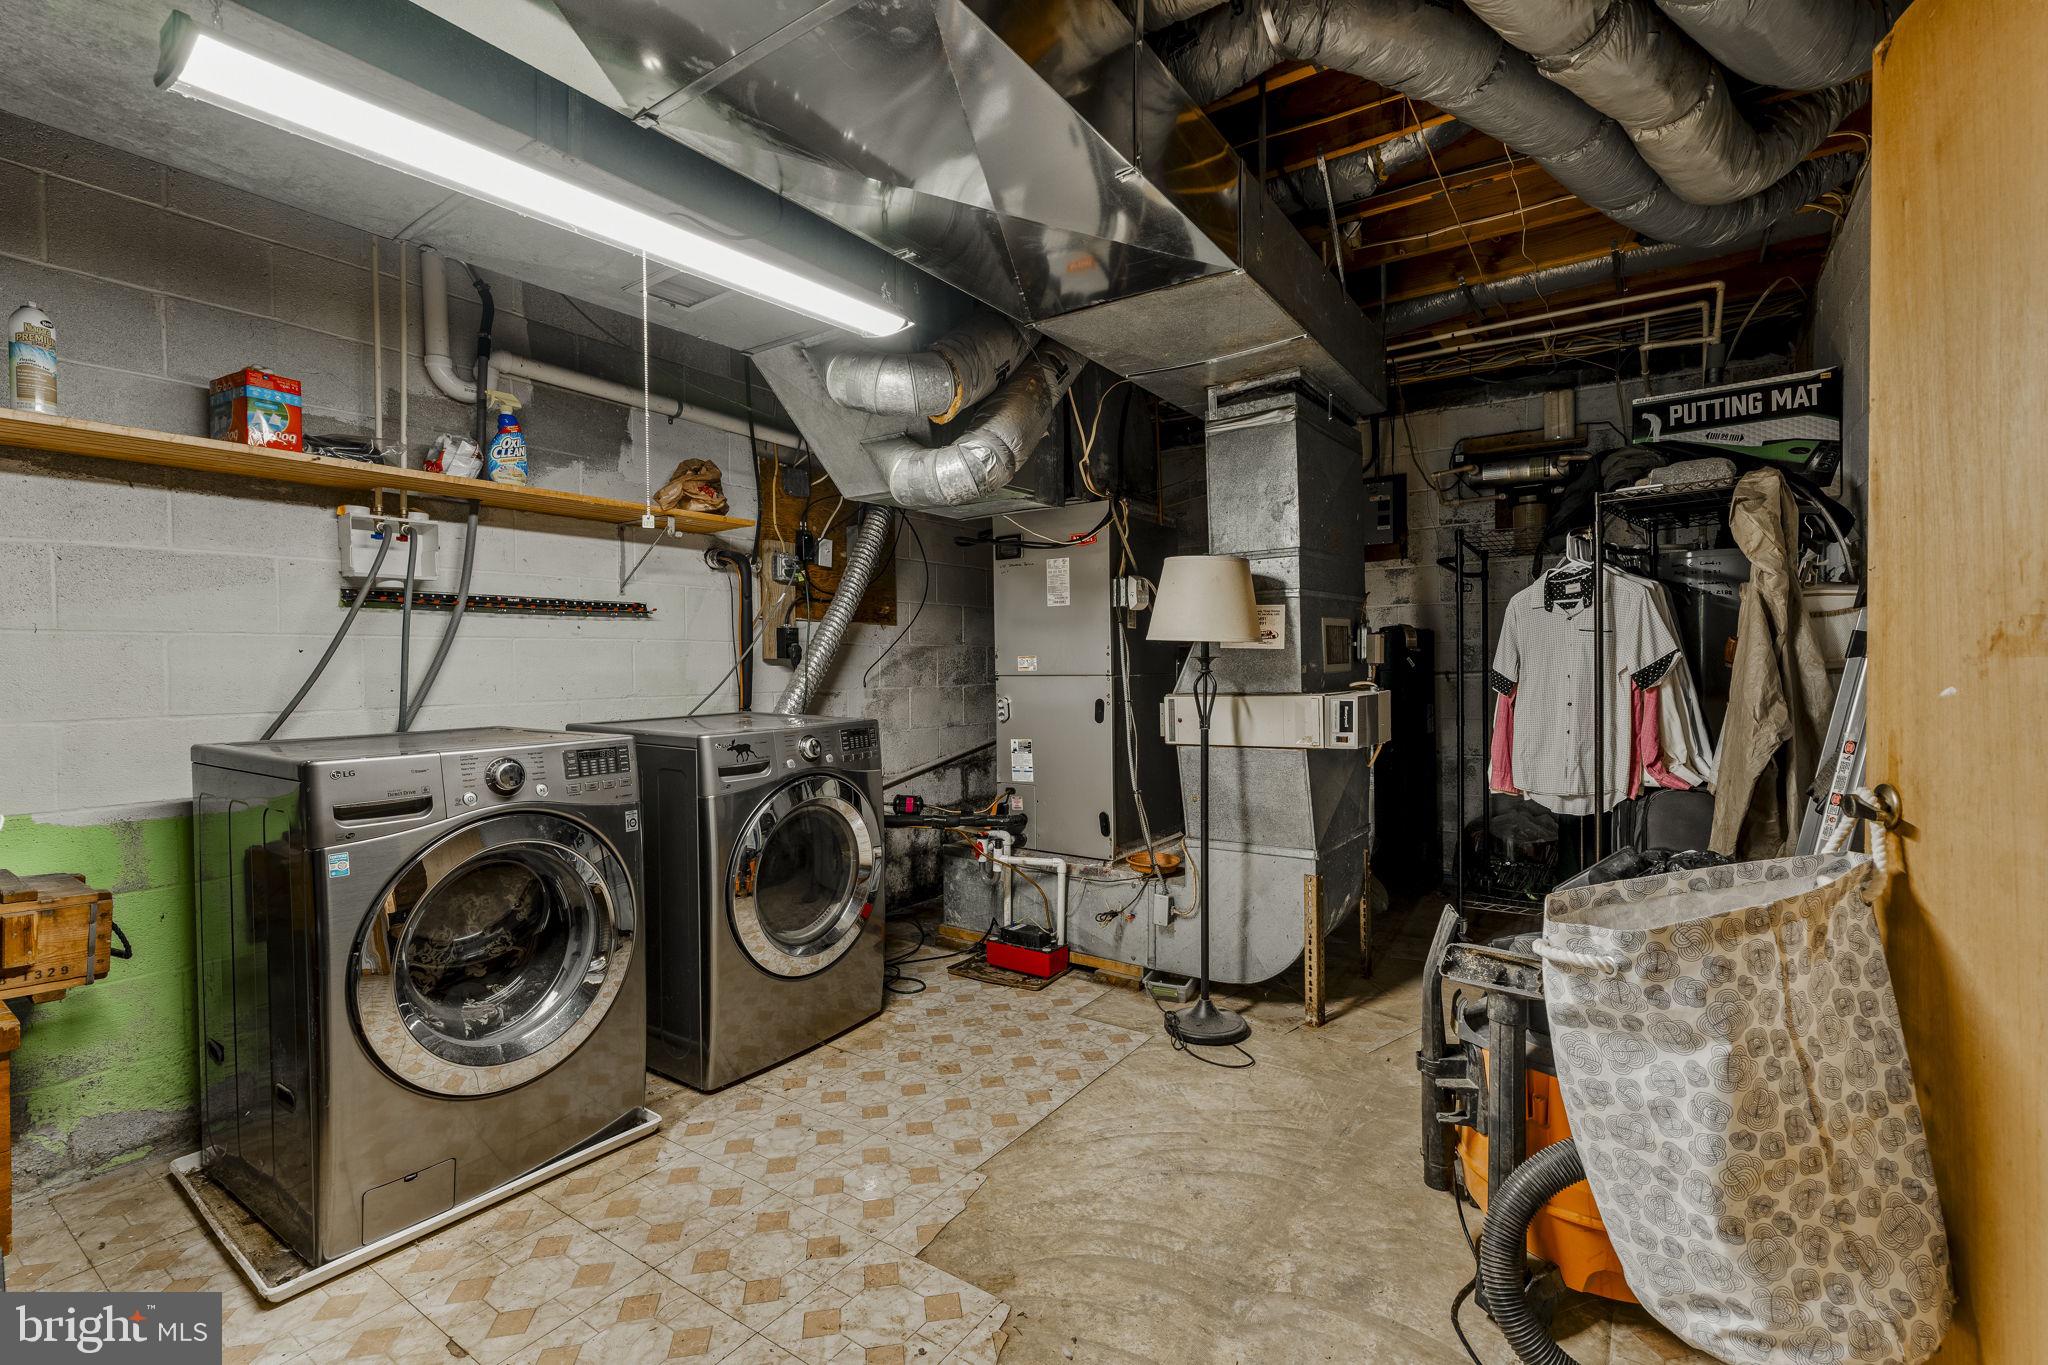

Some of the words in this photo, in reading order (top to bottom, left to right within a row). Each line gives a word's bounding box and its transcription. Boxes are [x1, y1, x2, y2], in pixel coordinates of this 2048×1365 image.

[1669, 392, 1763, 427] PUTTING
[1771, 382, 1822, 412] MAT
[492, 445, 526, 459] CLEAN
